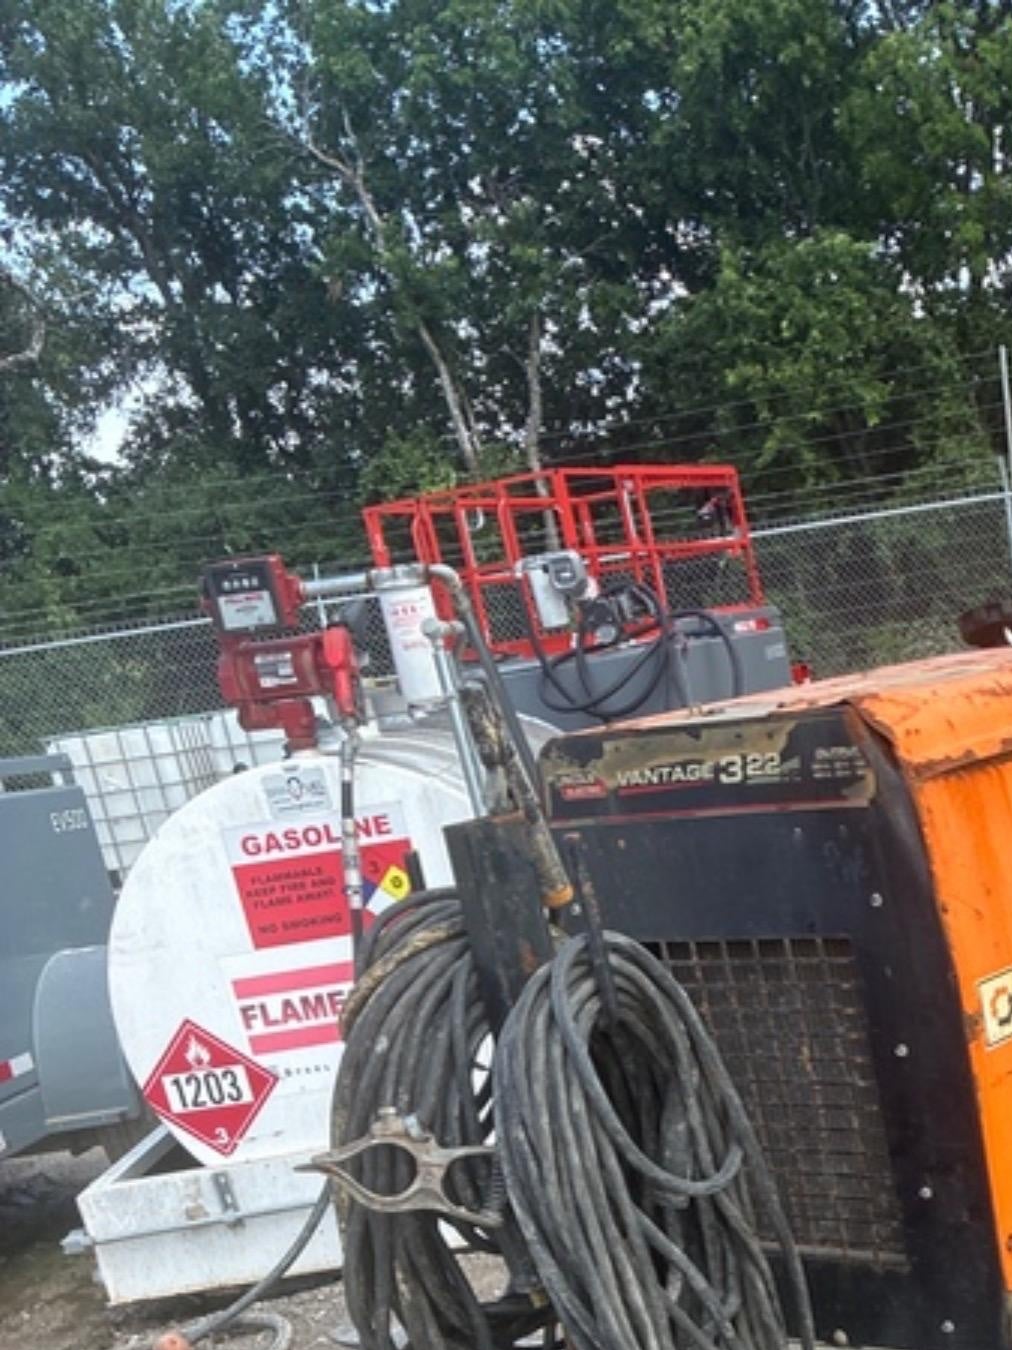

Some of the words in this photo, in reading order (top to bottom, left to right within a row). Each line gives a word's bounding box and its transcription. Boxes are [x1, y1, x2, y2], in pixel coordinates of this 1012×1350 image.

[616, 760, 714, 787] VANTAGE
[241, 813, 392, 856] GASOLNE
[171, 1069, 243, 1109] 1203
[214, 1126, 230, 1144] 3
